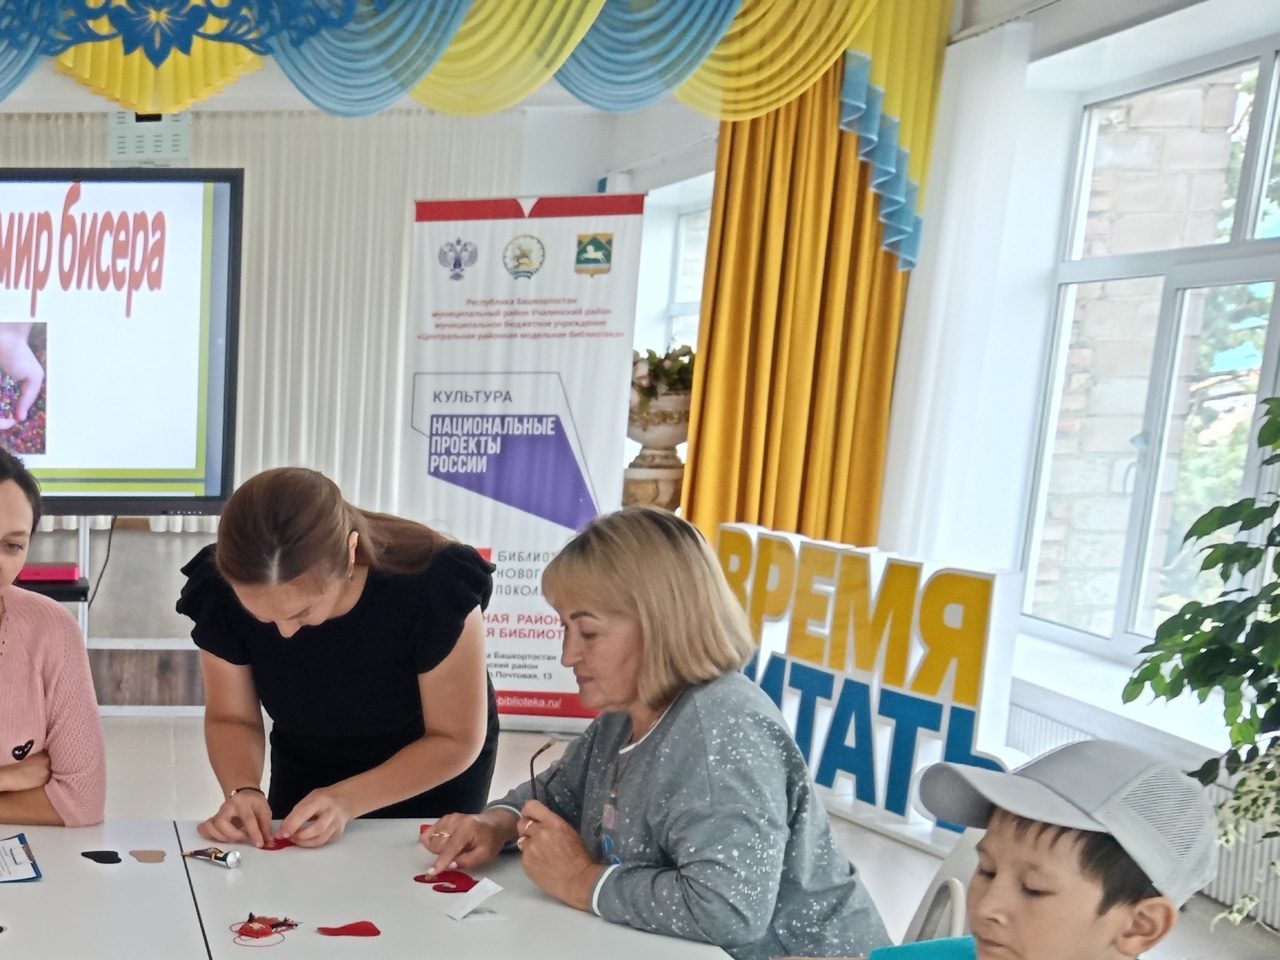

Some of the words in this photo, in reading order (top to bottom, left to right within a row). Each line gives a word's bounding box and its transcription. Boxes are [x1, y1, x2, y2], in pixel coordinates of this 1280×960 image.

[57, 180, 166, 318] бисера
[433, 391, 513, 403] КУЛЬТУРА
[431, 416, 557, 436] НАЦИОНАЛЬНЫЕ
[430, 435, 502, 454] ПРОЕКТЫ
[429, 455, 488, 473] РОССИИ
[497, 551, 557, 563] БИБЛИО
[496, 568, 541, 579] НОВОГ
[495, 584, 544, 597] ПОКОЛ
[482, 613, 509, 624] НАЯ
[517, 612, 561, 625] РАЙОН
[486, 627, 495, 637] Я
[499, 627, 564, 640] БИБЛИОТ
[493, 651, 557, 661] Башкортостан
